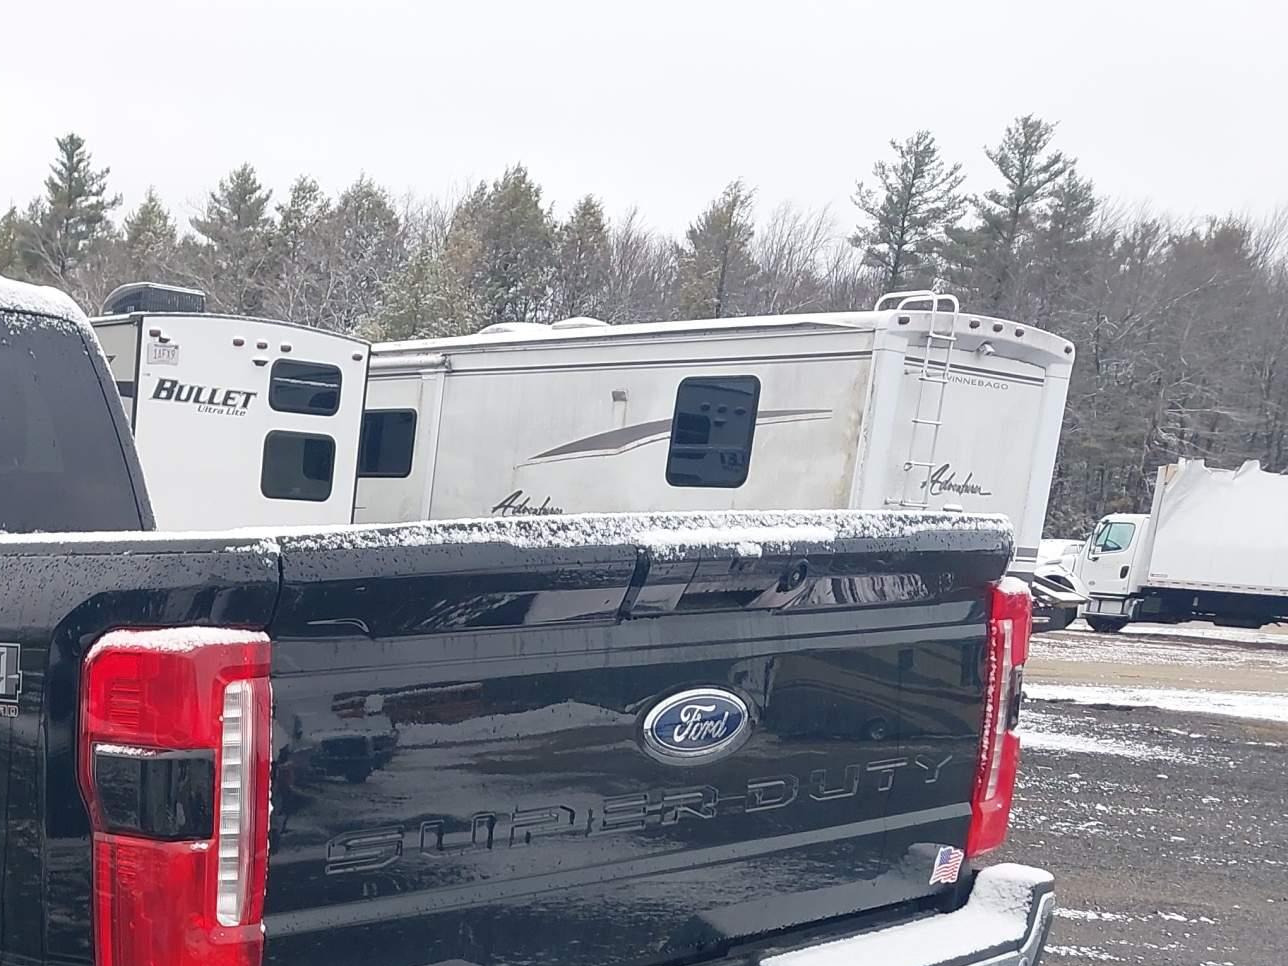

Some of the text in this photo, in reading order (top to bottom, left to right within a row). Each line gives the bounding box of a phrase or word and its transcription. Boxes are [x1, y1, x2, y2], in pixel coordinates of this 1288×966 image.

[151, 378, 257, 408] BULLET
[197, 404, 246, 417] Ultra Lite
[673, 704, 729, 743] Ford
[744, 755, 953, 815] DUTY
